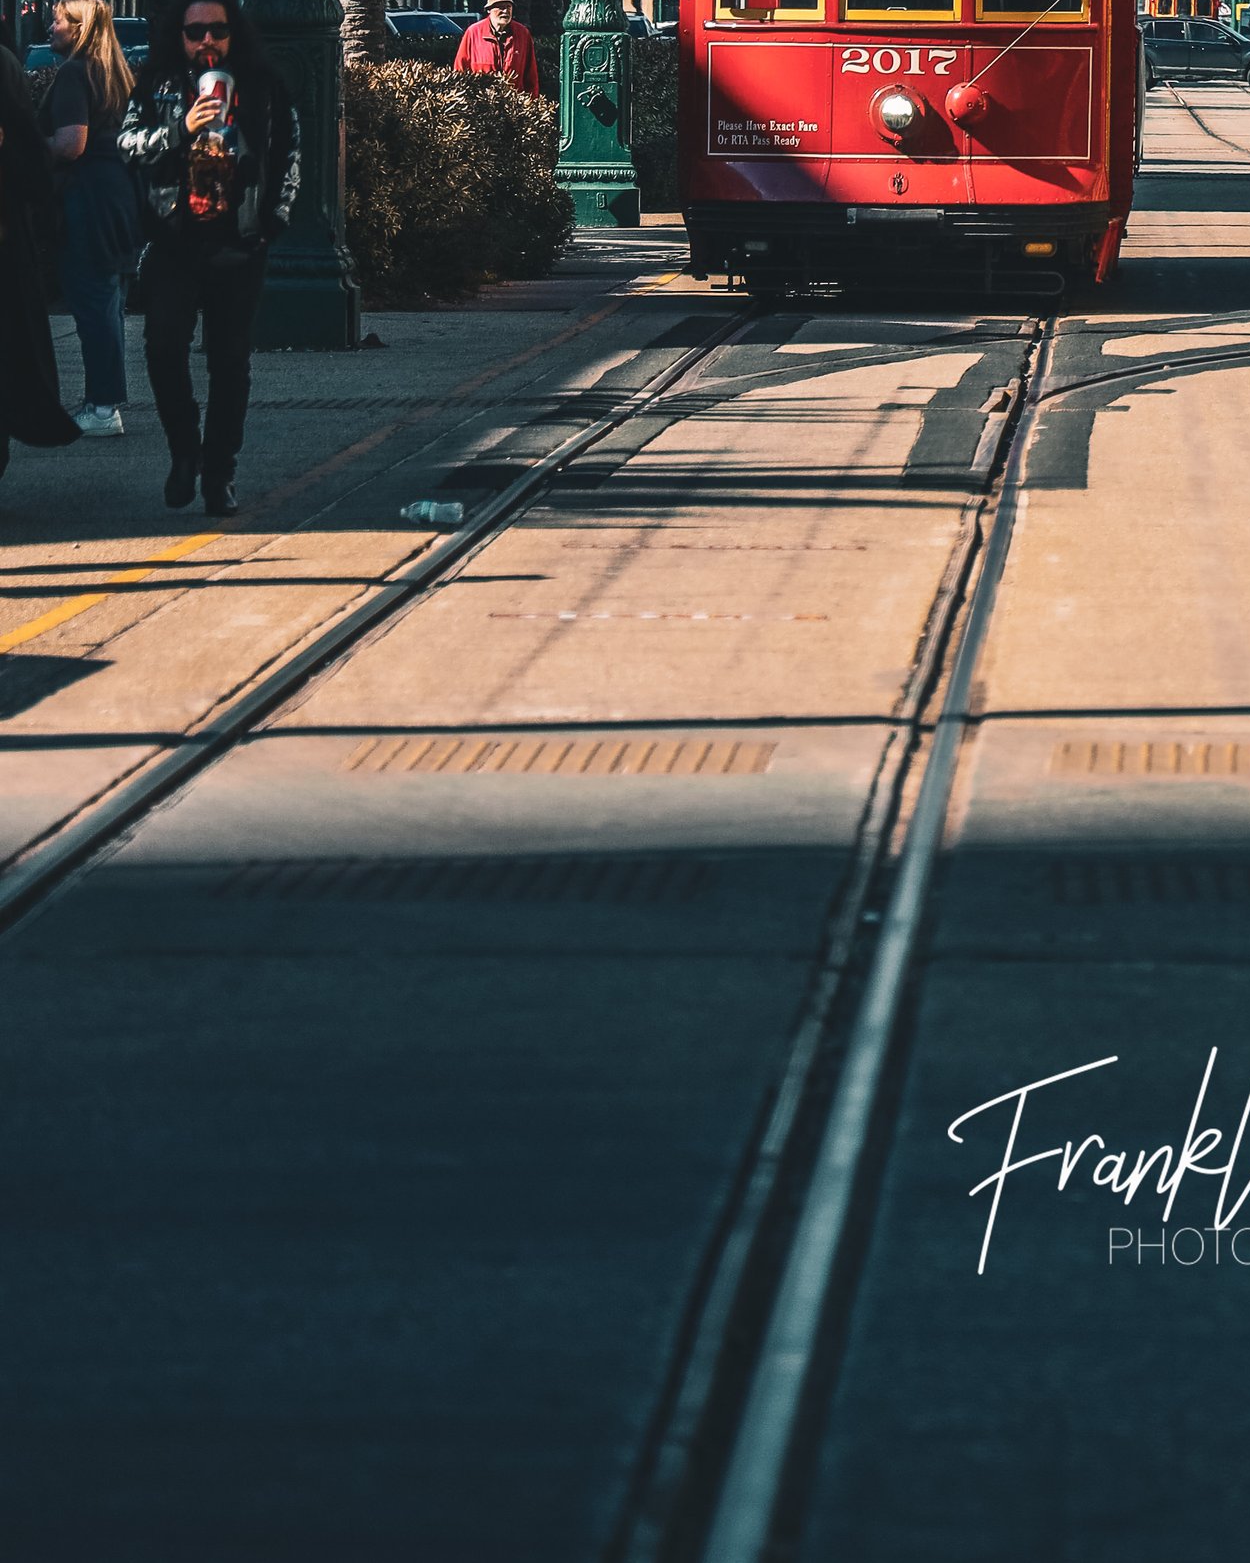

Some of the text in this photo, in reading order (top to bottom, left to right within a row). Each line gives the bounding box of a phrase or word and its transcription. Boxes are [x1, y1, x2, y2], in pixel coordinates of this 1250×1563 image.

[841, 48, 957, 75] 2017
[717, 120, 818, 132] Please Have Exact Fare
[717, 135, 801, 148] Or RTA Pass Ready
